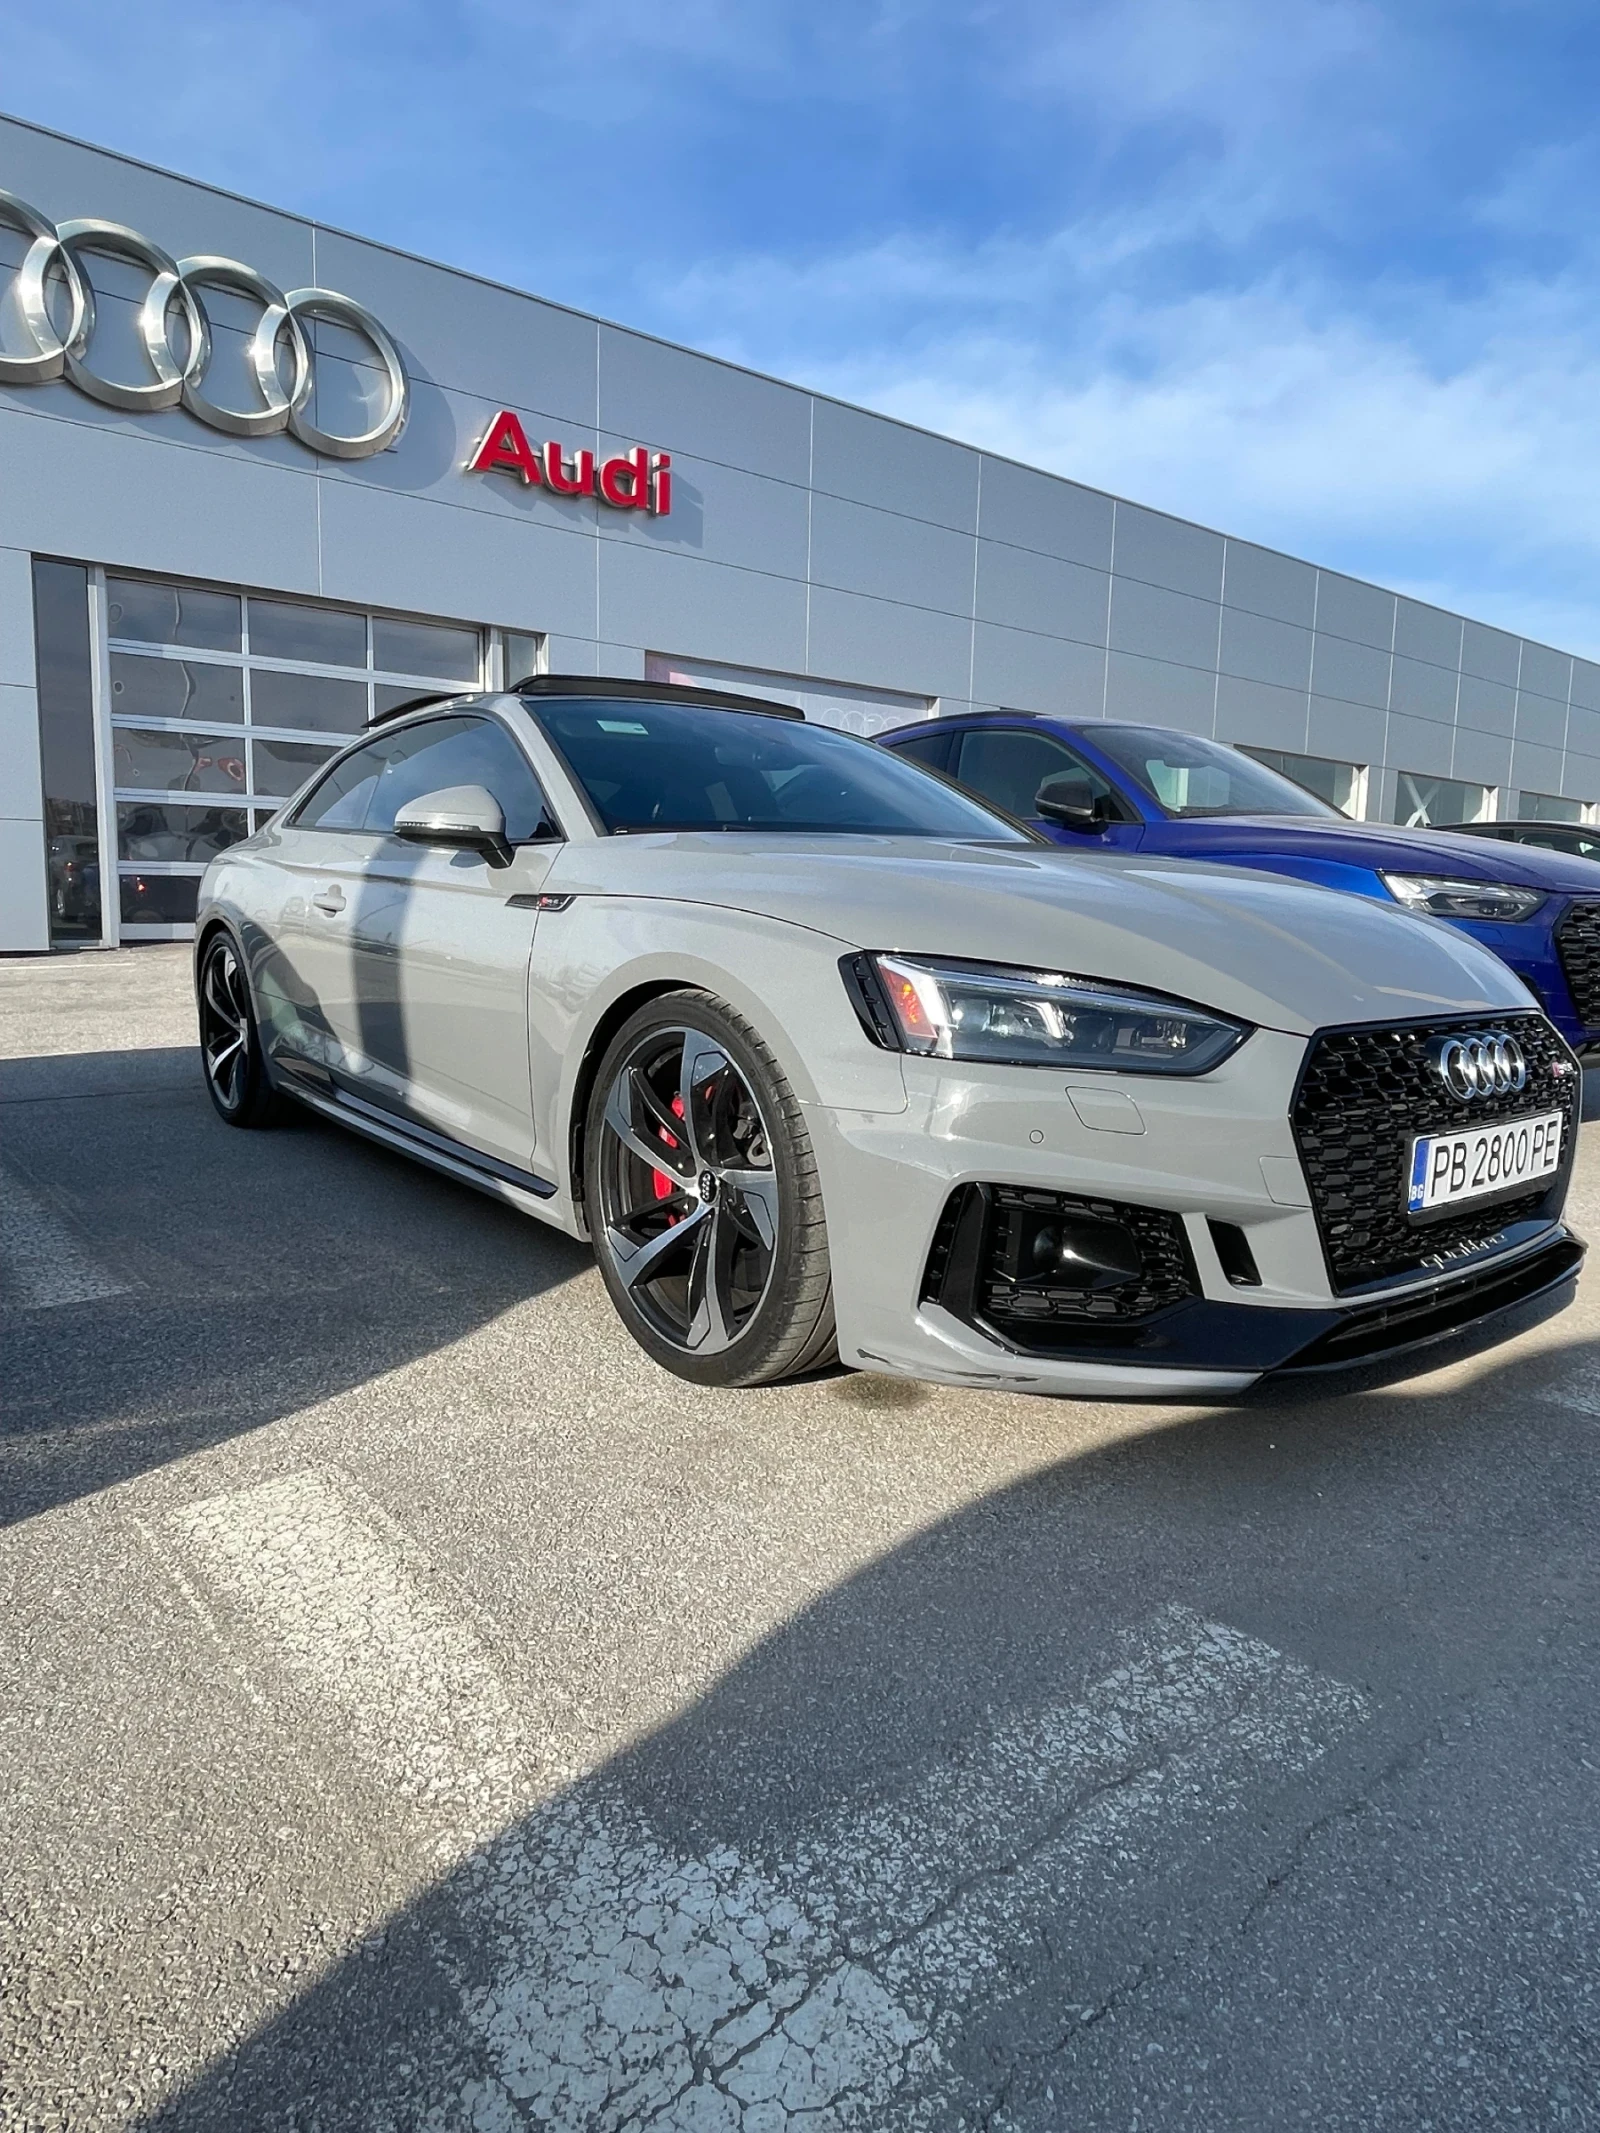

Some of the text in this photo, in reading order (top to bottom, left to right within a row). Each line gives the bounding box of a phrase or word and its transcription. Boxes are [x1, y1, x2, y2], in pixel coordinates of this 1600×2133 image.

[467, 411, 671, 516] Audi
[1410, 1184, 1425, 1202] BG
[1431, 1120, 1558, 1197] PB 2800 PE
